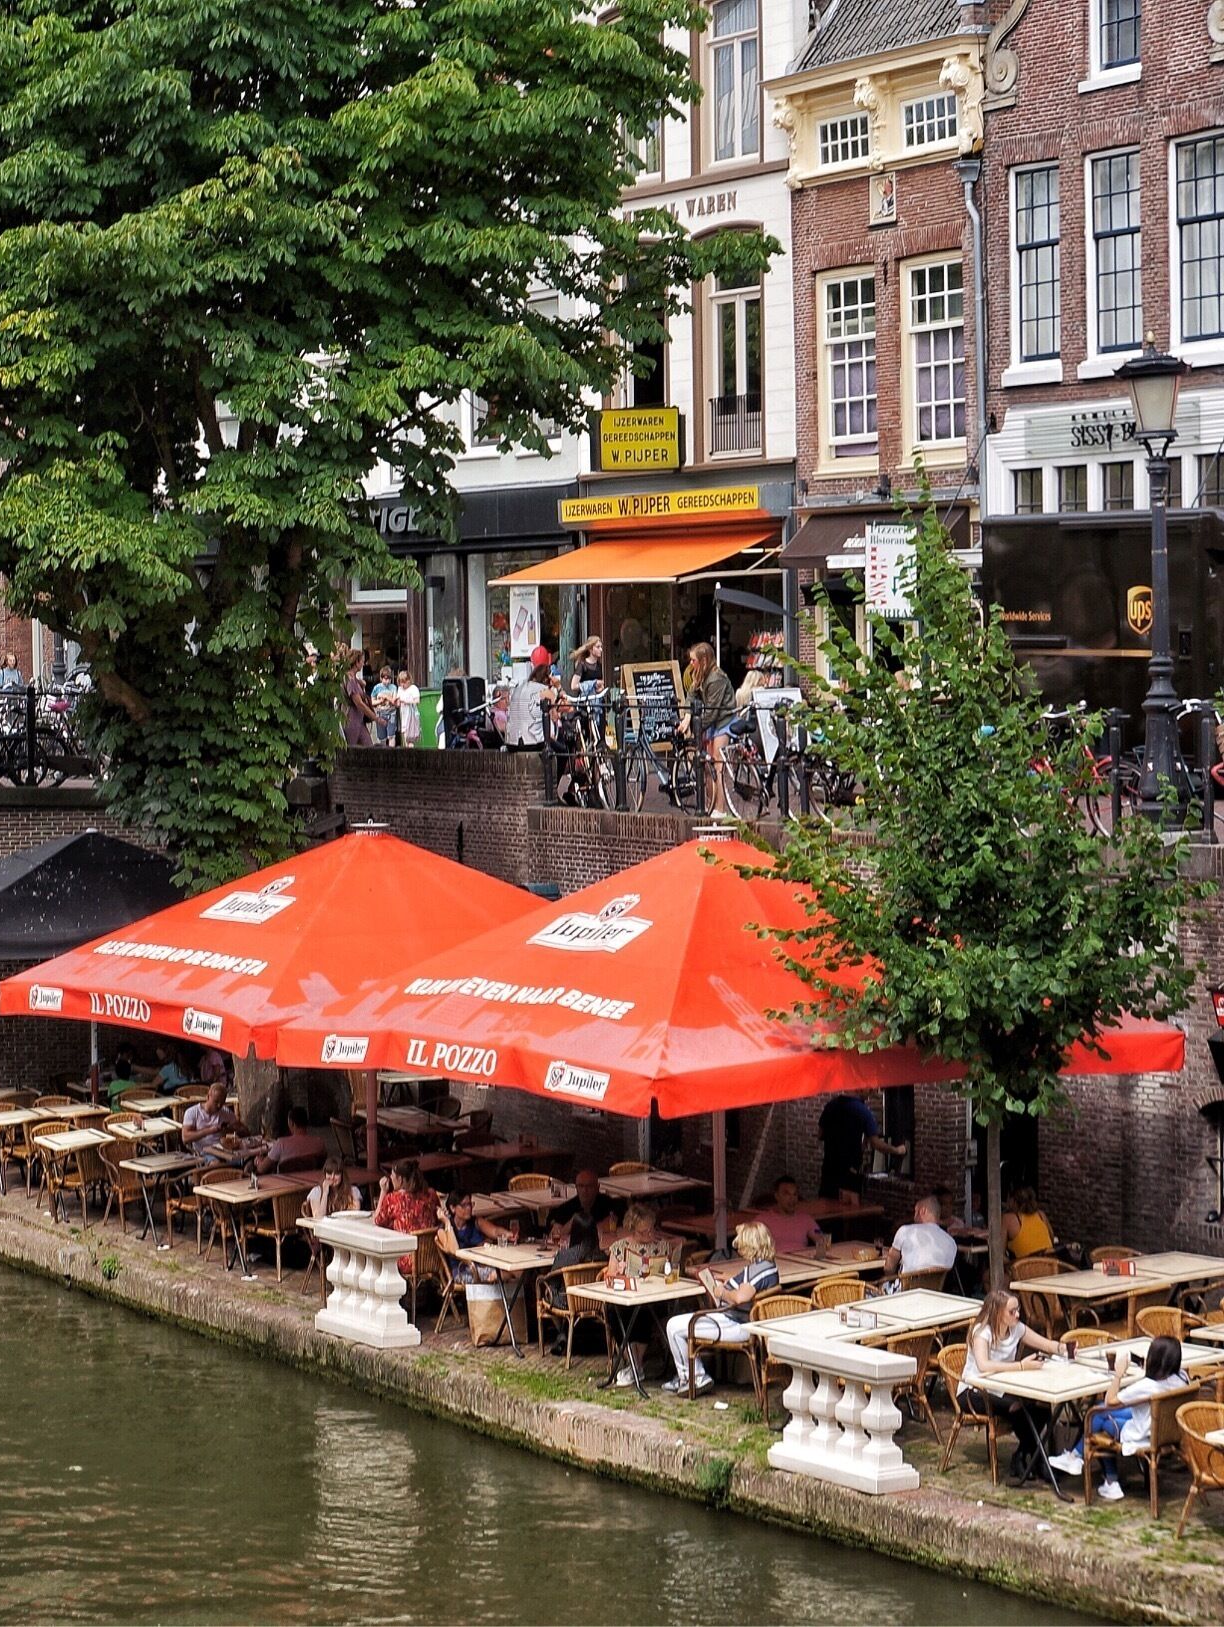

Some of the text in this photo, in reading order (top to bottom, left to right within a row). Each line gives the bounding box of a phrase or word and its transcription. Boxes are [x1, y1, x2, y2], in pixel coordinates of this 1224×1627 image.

[686, 189, 738, 219] WAREN
[613, 416, 665, 428] IJZERWAREN
[603, 431, 676, 443] GEREEDSCHAPPEN
[565, 502, 613, 517] IJZERWAREN
[677, 491, 755, 509] GEREEDSCHAPPEN
[1029, 611, 1051, 621] Services
[1130, 600, 1152, 627] ups
[213, 896, 280, 914] Jupiler
[535, 917, 634, 942] Jupiler
[39, 990, 61, 1006] Jupiler
[89, 992, 151, 1023] IL POZZO
[459, 977, 518, 1001] EVEN
[510, 986, 565, 1004] NAAR
[557, 989, 635, 1020] BENEE
[194, 1015, 220, 1034] Jupiler
[336, 1041, 366, 1058] Jupiler
[406, 1038, 497, 1077] IL POZZO
[565, 1071, 606, 1092] Jupiler
